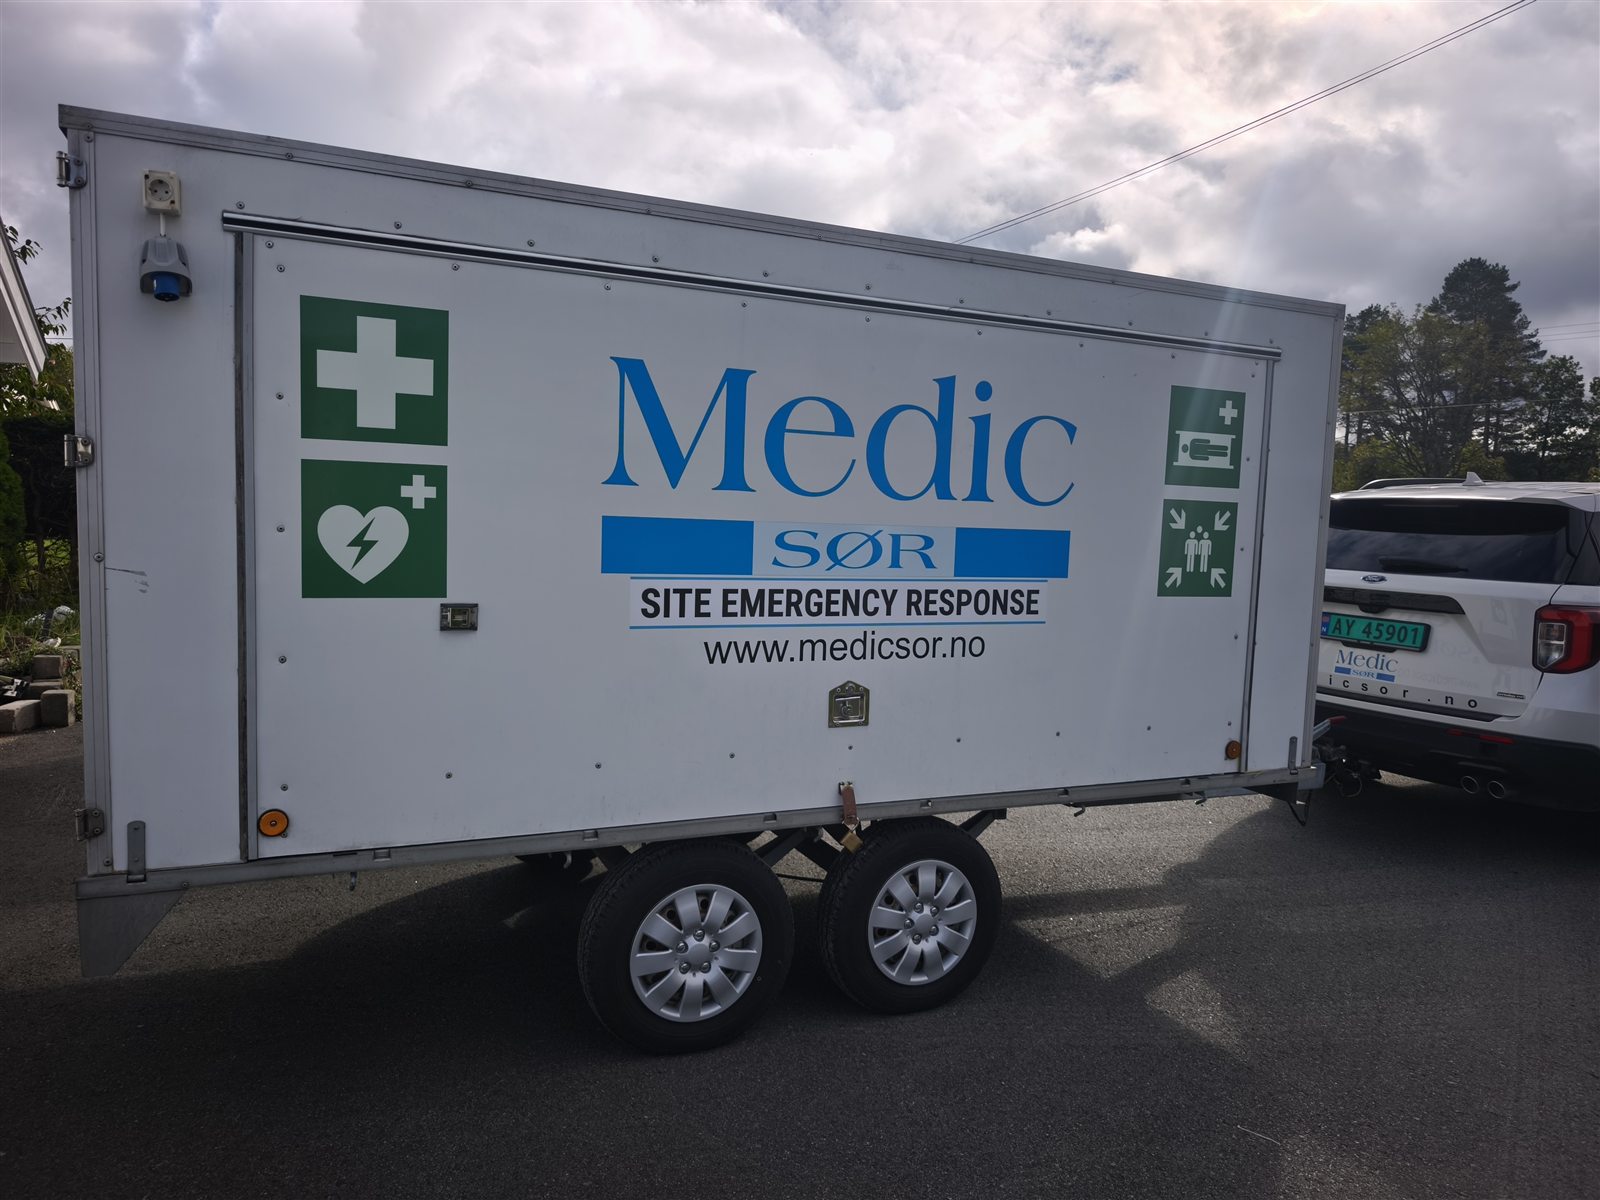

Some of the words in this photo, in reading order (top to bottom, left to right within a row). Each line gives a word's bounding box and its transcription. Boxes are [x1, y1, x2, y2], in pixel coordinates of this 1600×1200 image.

[601, 356, 1078, 507] Medic
[771, 529, 938, 572] SØR
[640, 588, 712, 619] SITE
[721, 588, 898, 618] EMERGENCY
[905, 589, 1041, 617] RESPONSE
[1331, 618, 1356, 637] AY
[1361, 622, 1419, 645] 45901
[703, 631, 986, 665] www.medicsor.no
[1336, 650, 1399, 673] Medic
